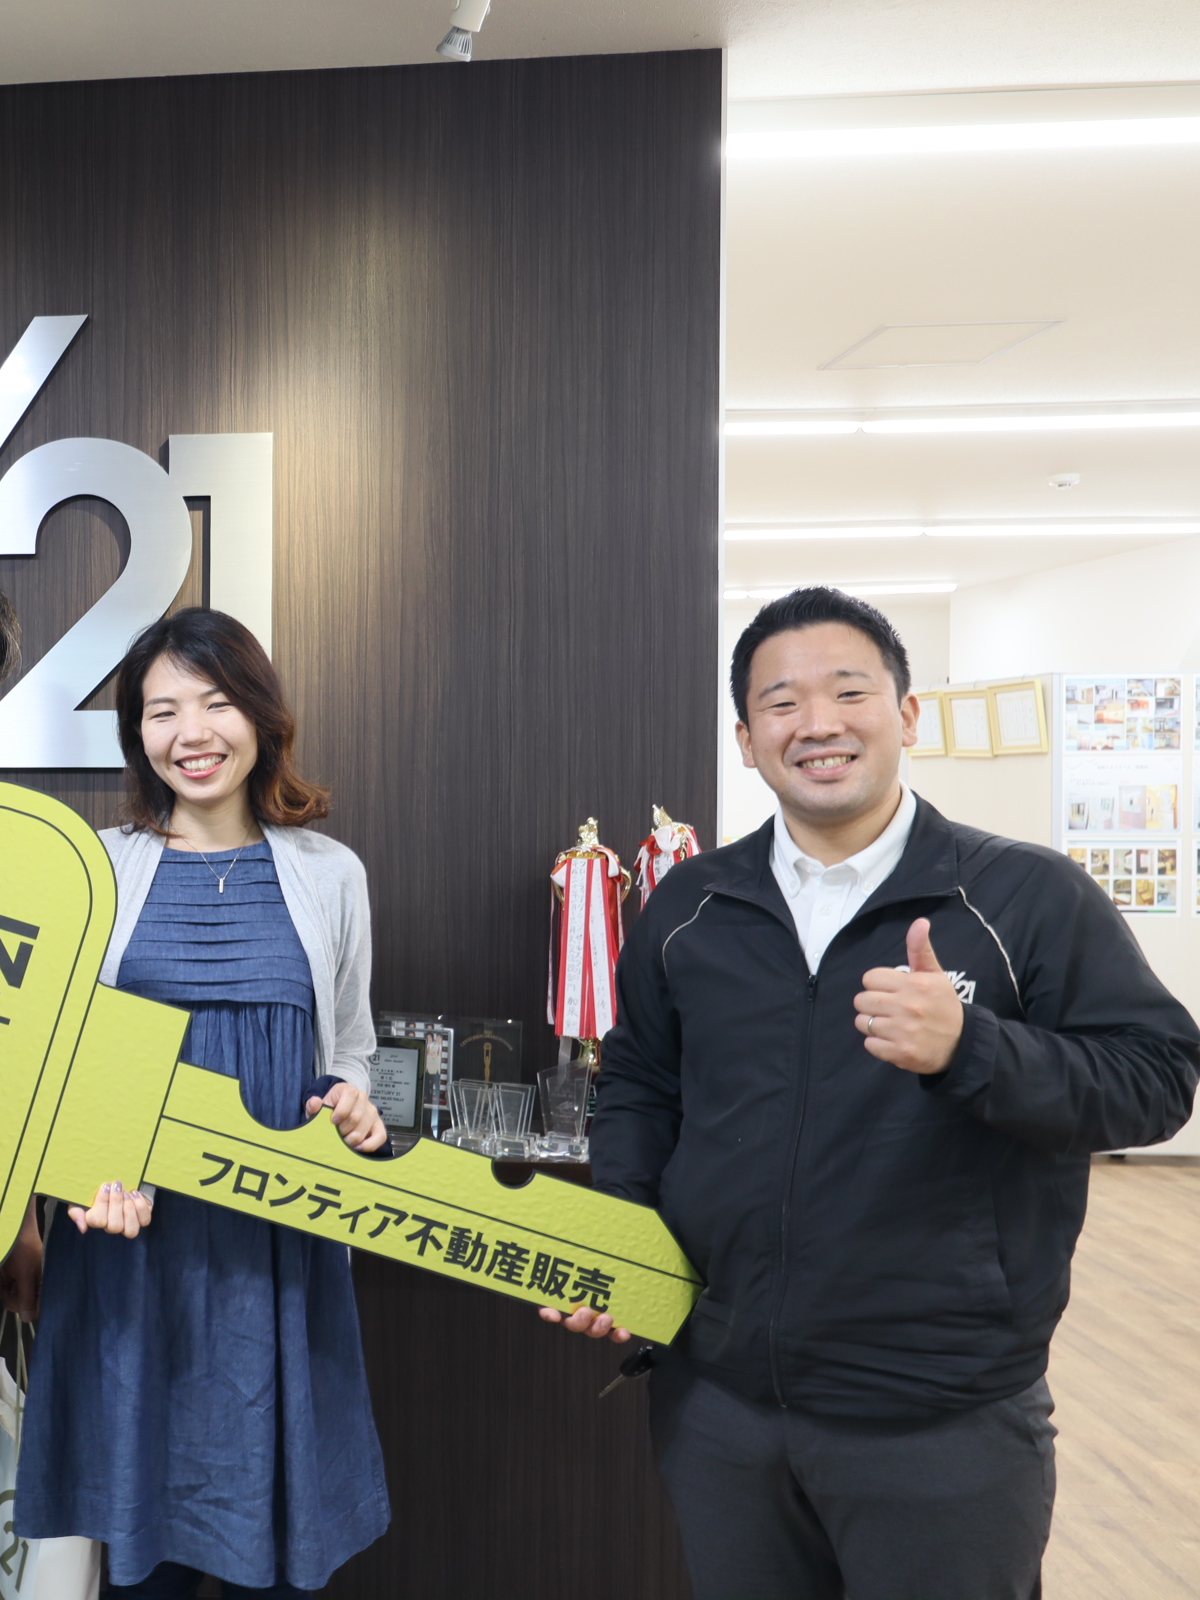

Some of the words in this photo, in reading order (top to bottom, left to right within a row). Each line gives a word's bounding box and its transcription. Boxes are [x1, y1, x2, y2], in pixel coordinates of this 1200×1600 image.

[198, 1151, 616, 1313] フロンティア不動産販売
